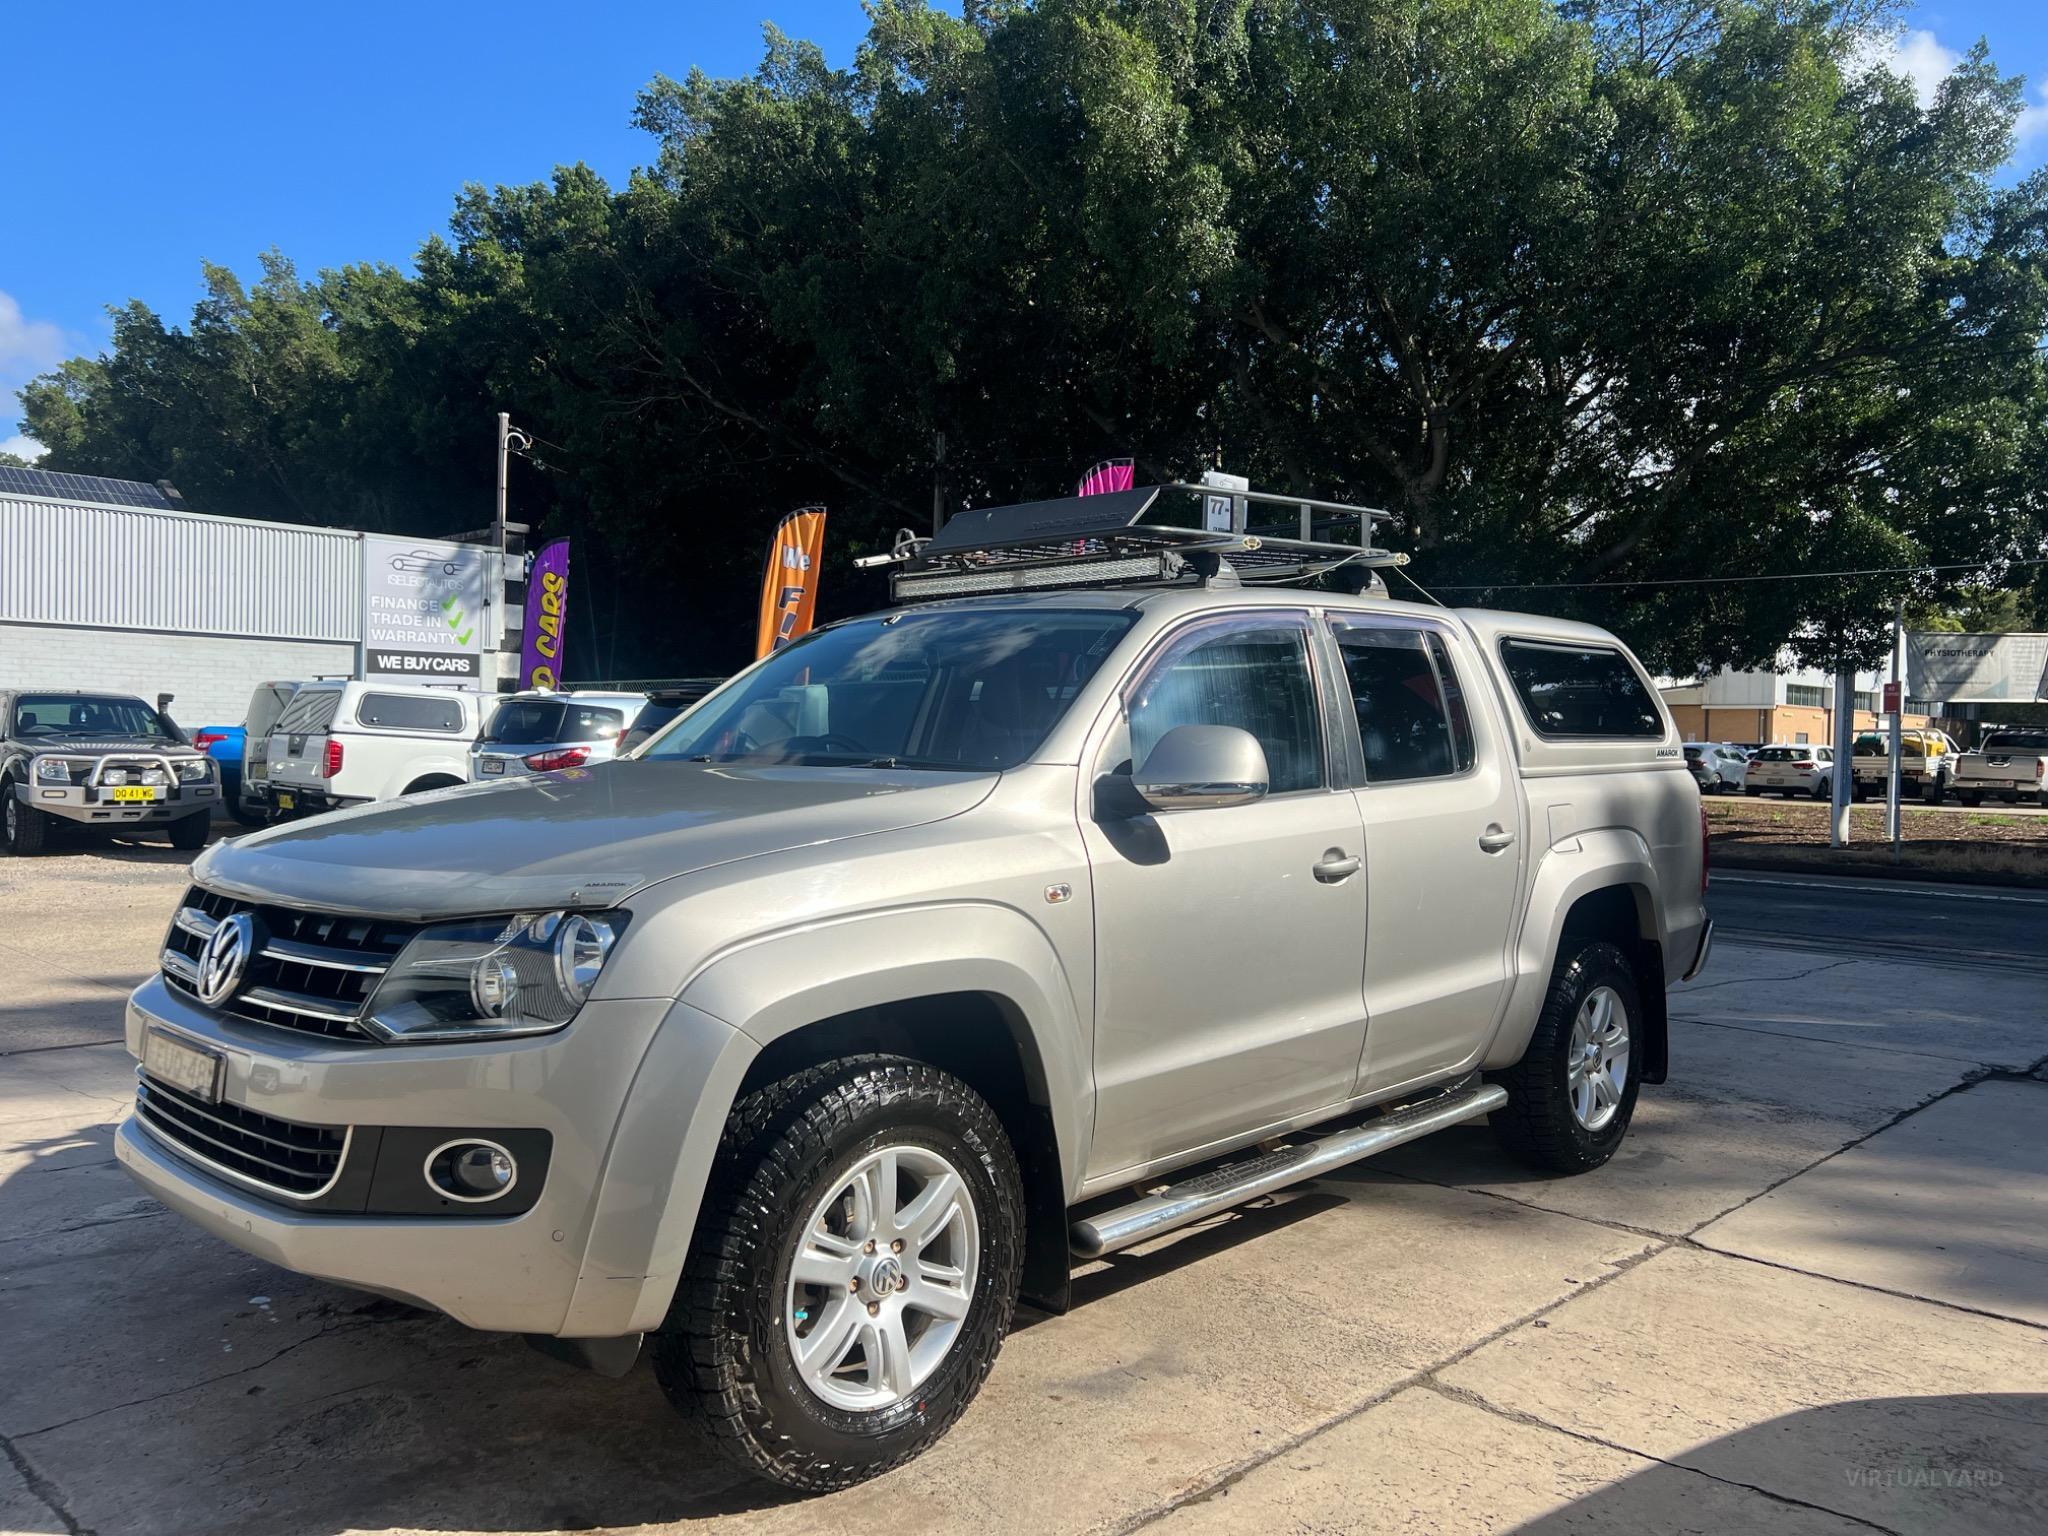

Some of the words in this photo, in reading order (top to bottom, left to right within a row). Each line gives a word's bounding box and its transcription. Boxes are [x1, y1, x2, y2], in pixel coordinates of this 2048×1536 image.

[782, 544, 811, 571] We
[370, 595, 440, 612] FINANCE
[371, 612, 423, 627] TRADE
[426, 616, 442, 628] IN
[535, 571, 565, 659] CARS
[371, 628, 457, 645] WARRANTY
[1924, 649, 1995, 658] PHYSIOTHERAPY
[377, 655, 402, 670] WE
[403, 657, 432, 671] BUY
[432, 658, 471, 673] CARS
